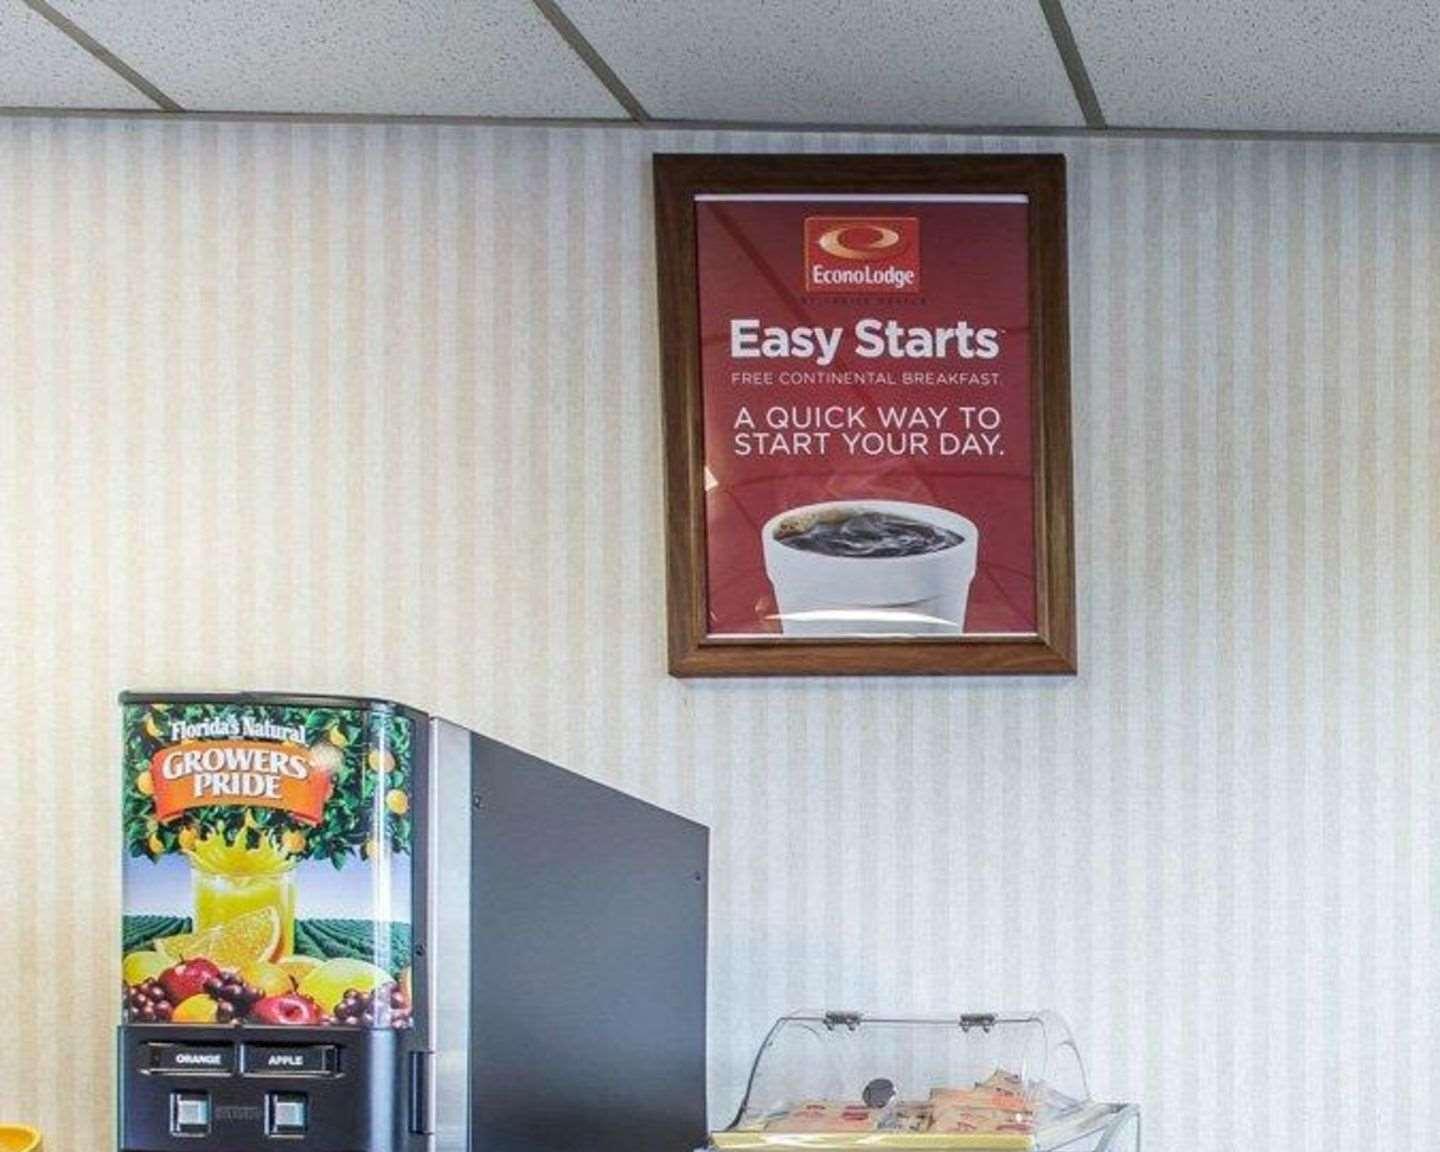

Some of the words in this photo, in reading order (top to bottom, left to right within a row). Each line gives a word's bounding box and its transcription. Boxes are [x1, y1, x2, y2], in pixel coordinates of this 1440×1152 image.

[812, 264, 915, 289] EconoLodge
[730, 318, 843, 366] Easy
[855, 317, 1000, 359] Starts
[731, 372, 773, 385] FREE
[779, 372, 896, 385] CONTINENTAL
[734, 406, 755, 429] A
[766, 405, 866, 430] QUICK
[877, 406, 948, 429] WAY
[959, 406, 1000, 430] TO
[734, 432, 830, 455] START
[842, 432, 928, 455] YOUR
[940, 432, 1004, 456] DAY.
[171, 716, 240, 741] Florida's
[243, 716, 306, 744] Natural
[162, 748, 308, 780] GROWERS
[193, 772, 283, 798] PRIDE
[175, 1053, 222, 1065] ORANGE
[268, 1055, 303, 1066] APPLE
